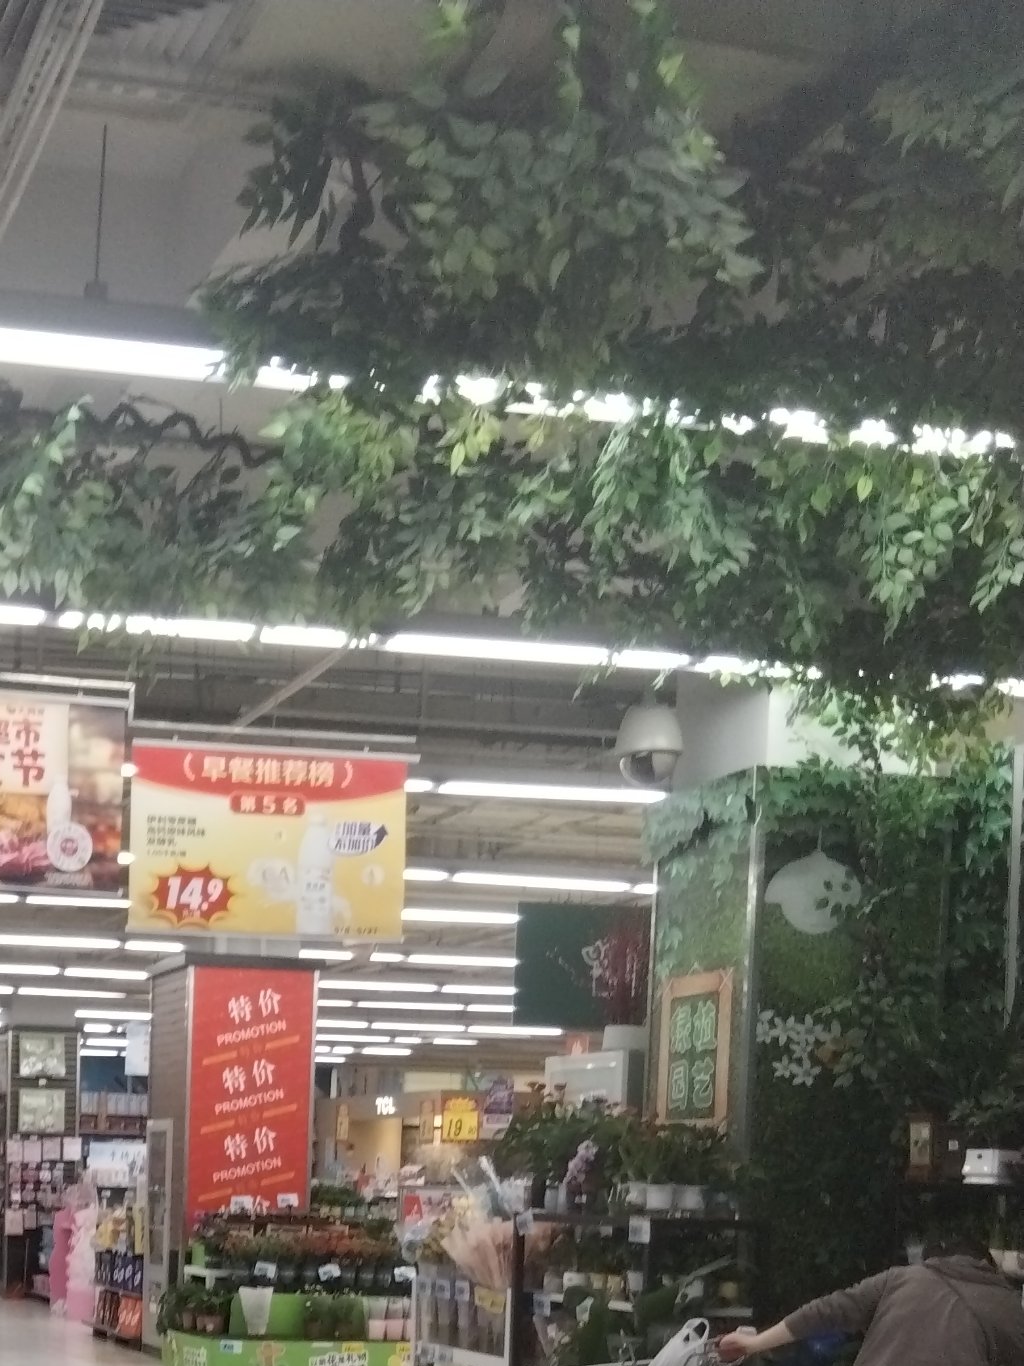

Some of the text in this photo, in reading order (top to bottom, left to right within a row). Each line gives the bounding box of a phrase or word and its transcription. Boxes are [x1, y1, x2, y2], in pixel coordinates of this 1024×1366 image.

[201, 755, 336, 788] 早餐推荐榜
[239, 795, 299, 814] 第5名
[227, 987, 283, 1025] 特价
[216, 1018, 287, 1047] PROMOTION
[221, 1058, 277, 1095] 特价
[214, 1088, 285, 1116] PROMOTION
[375, 1096, 396, 1115] TCL
[223, 1125, 278, 1163] 特价
[212, 1156, 283, 1184] PROMOTION
